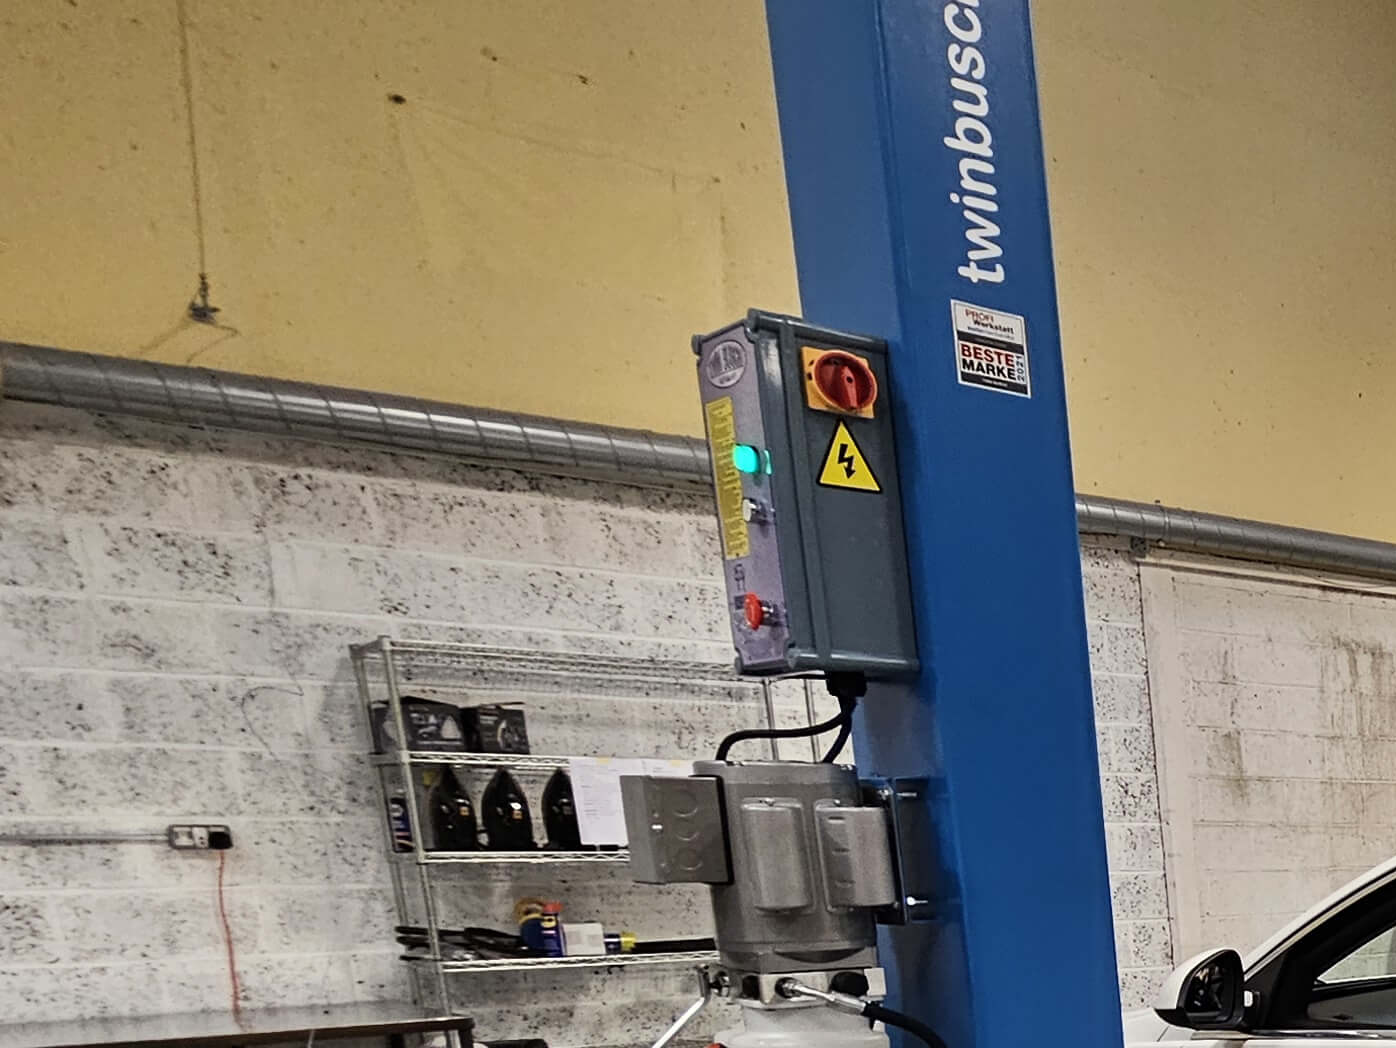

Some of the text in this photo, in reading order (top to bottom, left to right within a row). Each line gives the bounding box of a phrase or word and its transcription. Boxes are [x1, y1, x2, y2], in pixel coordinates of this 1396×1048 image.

[943, 0, 1005, 283] twinbusc
[960, 343, 1015, 369] BESTE
[961, 358, 1017, 381] MARKE
